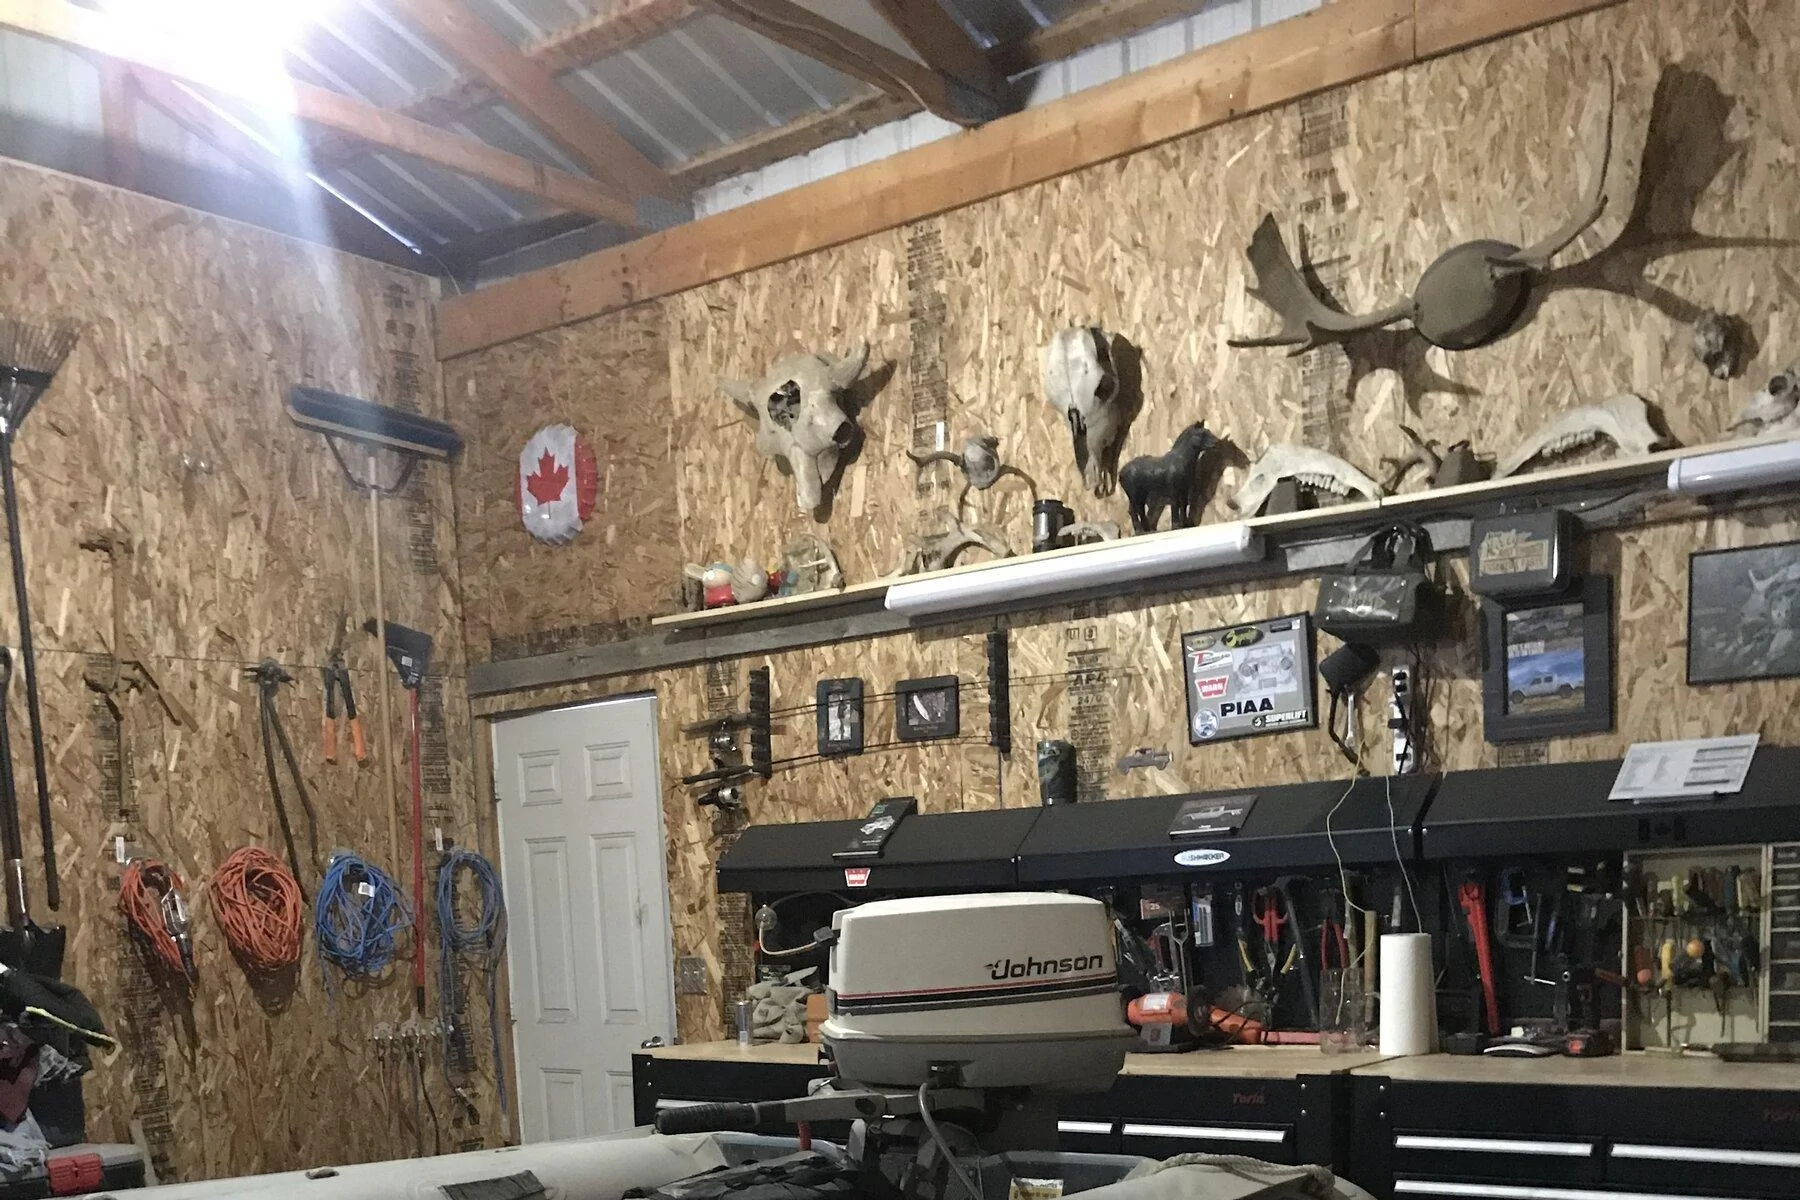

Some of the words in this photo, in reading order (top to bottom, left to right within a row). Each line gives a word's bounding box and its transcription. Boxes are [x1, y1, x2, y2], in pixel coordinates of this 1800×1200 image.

[1220, 697, 1274, 717] PIAA
[1265, 710, 1306, 723] SUPERLIFT
[991, 955, 1103, 980] Johnson
